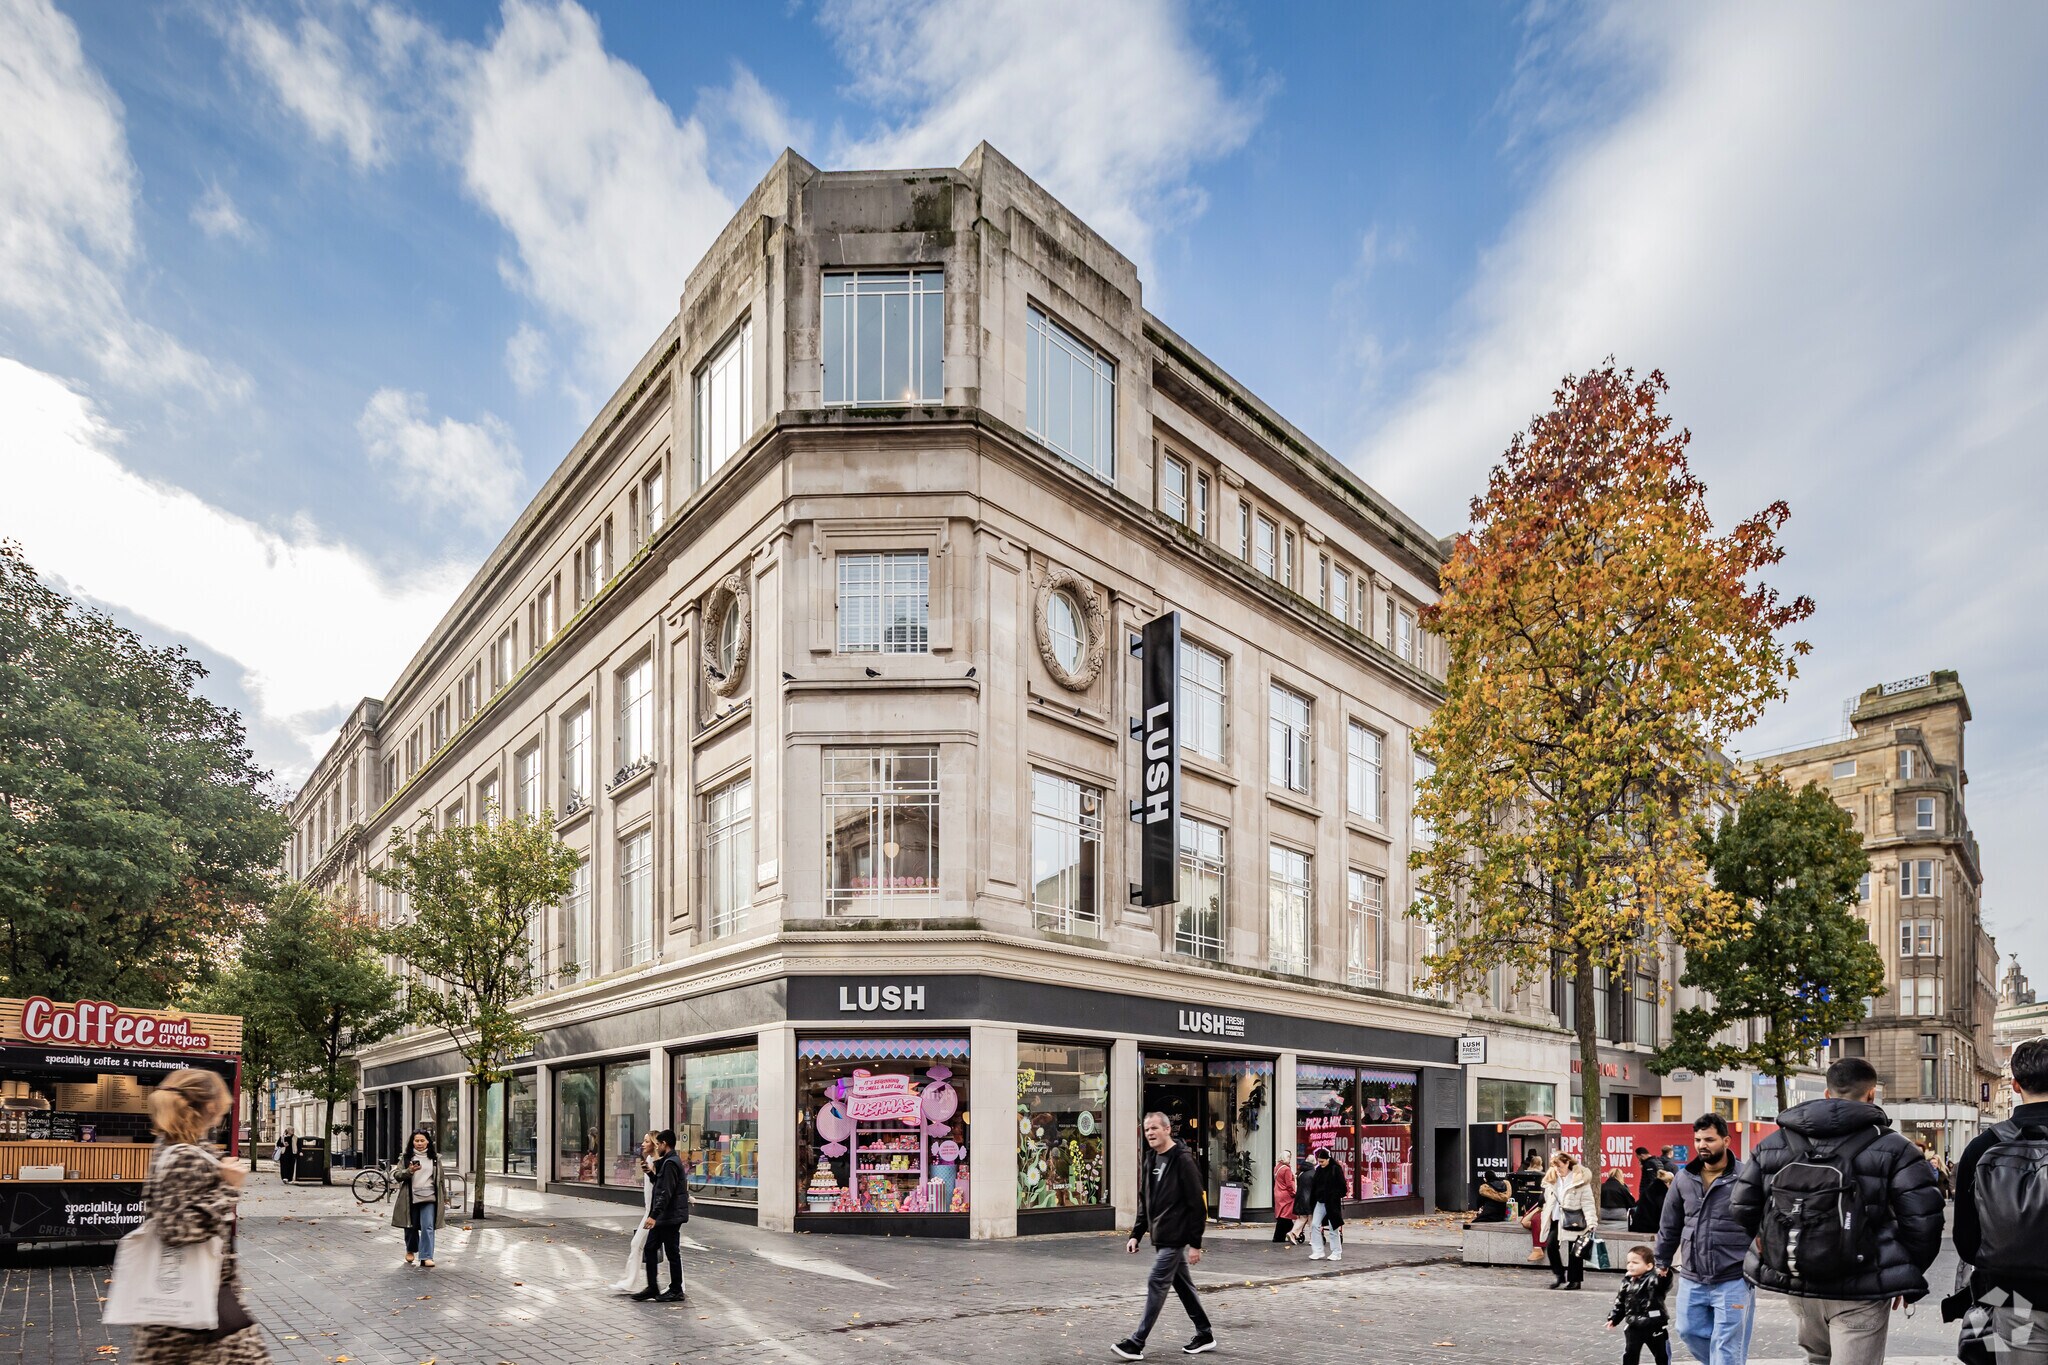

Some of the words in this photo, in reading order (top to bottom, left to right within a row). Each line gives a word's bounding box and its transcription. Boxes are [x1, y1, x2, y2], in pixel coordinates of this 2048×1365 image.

[1146, 701, 1169, 825] LUSH
[839, 985, 926, 1012] LUSH
[25, 999, 155, 1045] Coffee
[159, 1020, 187, 1036] and
[1178, 1009, 1225, 1035] LUSH
[1225, 1015, 1245, 1026] FRESH
[159, 1032, 207, 1048] crepes
[45, 1055, 91, 1067] speciality
[93, 1056, 120, 1066] coffee
[123, 1058, 130, 1067] &
[132, 1059, 190, 1071] refreshments
[852, 1098, 915, 1118] LUSHMAS
[1305, 1117, 1322, 1131] PICK
[1322, 1116, 1329, 1129] &
[1329, 1115, 1342, 1128] MIX
[1606, 1136, 1633, 1153] ONE
[1476, 1157, 1508, 1168] LUSH
[1609, 1154, 1633, 1167] WAY
[64, 1200, 122, 1216] speciality
[126, 1200, 147, 1212] cof
[67, 1213, 76, 1225] &
[80, 1212, 146, 1225] refreshmen
[38, 1224, 78, 1237] CREPES
